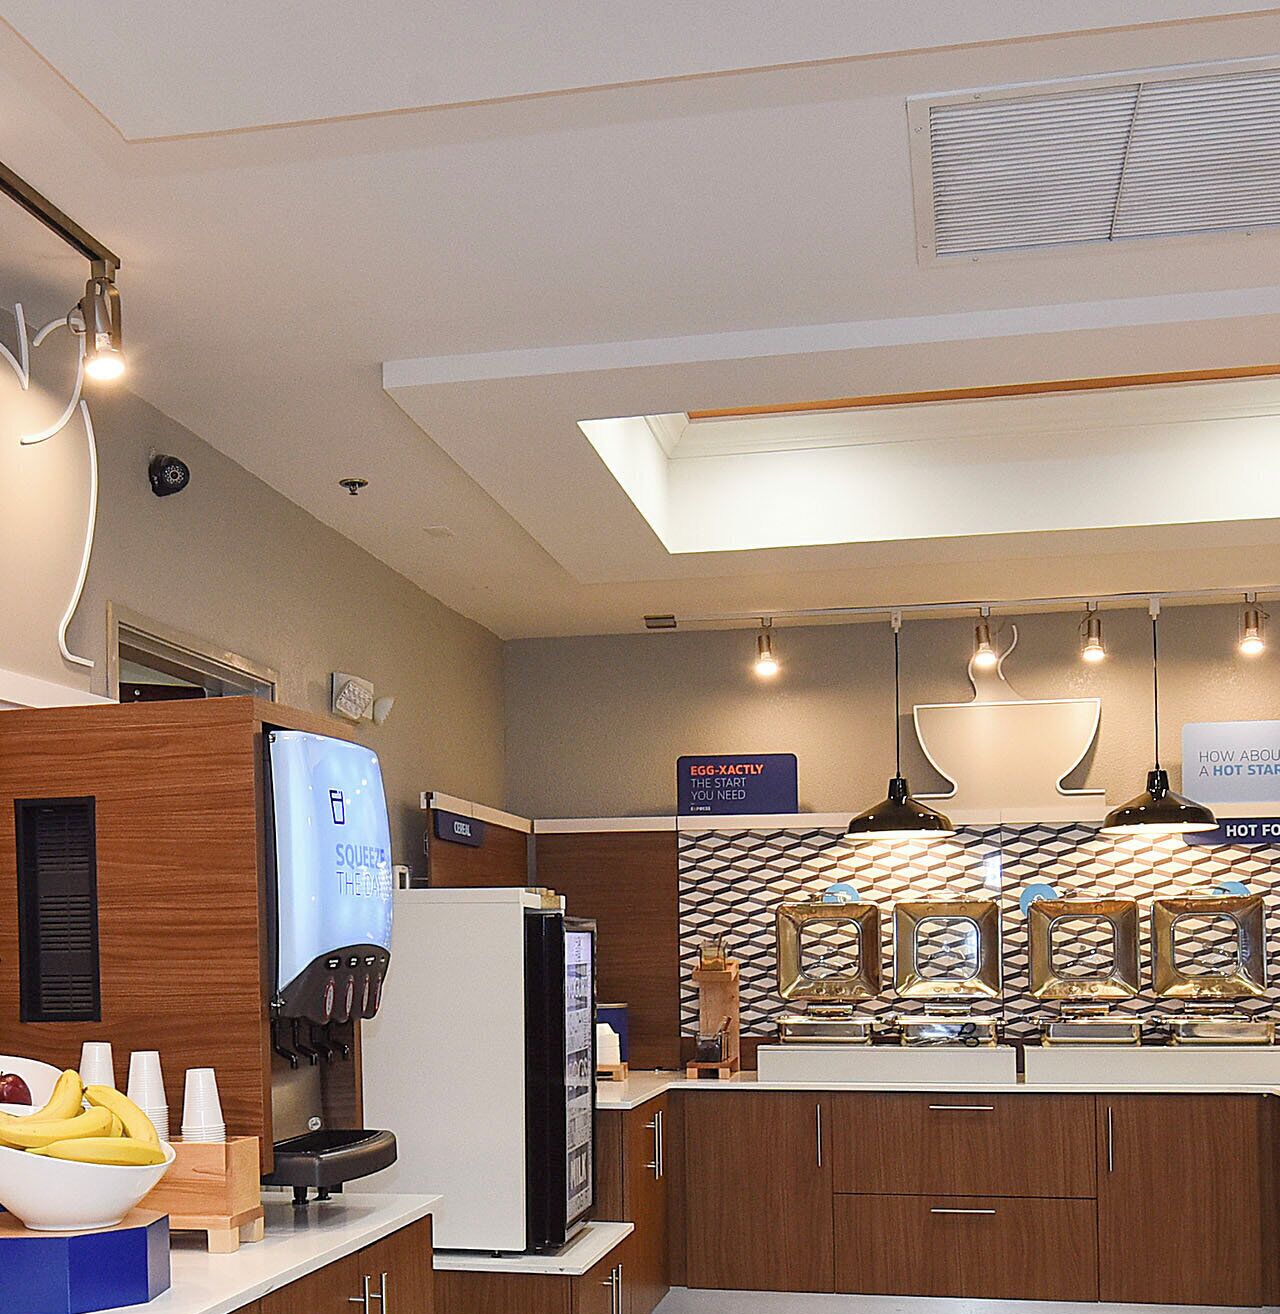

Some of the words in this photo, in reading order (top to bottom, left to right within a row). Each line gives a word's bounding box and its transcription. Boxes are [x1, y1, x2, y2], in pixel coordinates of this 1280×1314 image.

[1199, 750, 1235, 763] HOW
[690, 764, 764, 776] EGG-XACTLY
[1199, 765, 1209, 777] A
[1213, 764, 1243, 776] HOT
[691, 778, 712, 788] THE
[714, 777, 746, 788] START
[691, 790, 714, 801] YOU
[717, 789, 746, 800] NEED
[1226, 824, 1258, 837] HOT
[335, 843, 385, 869] SQUEEZE
[336, 871, 361, 896] THE
